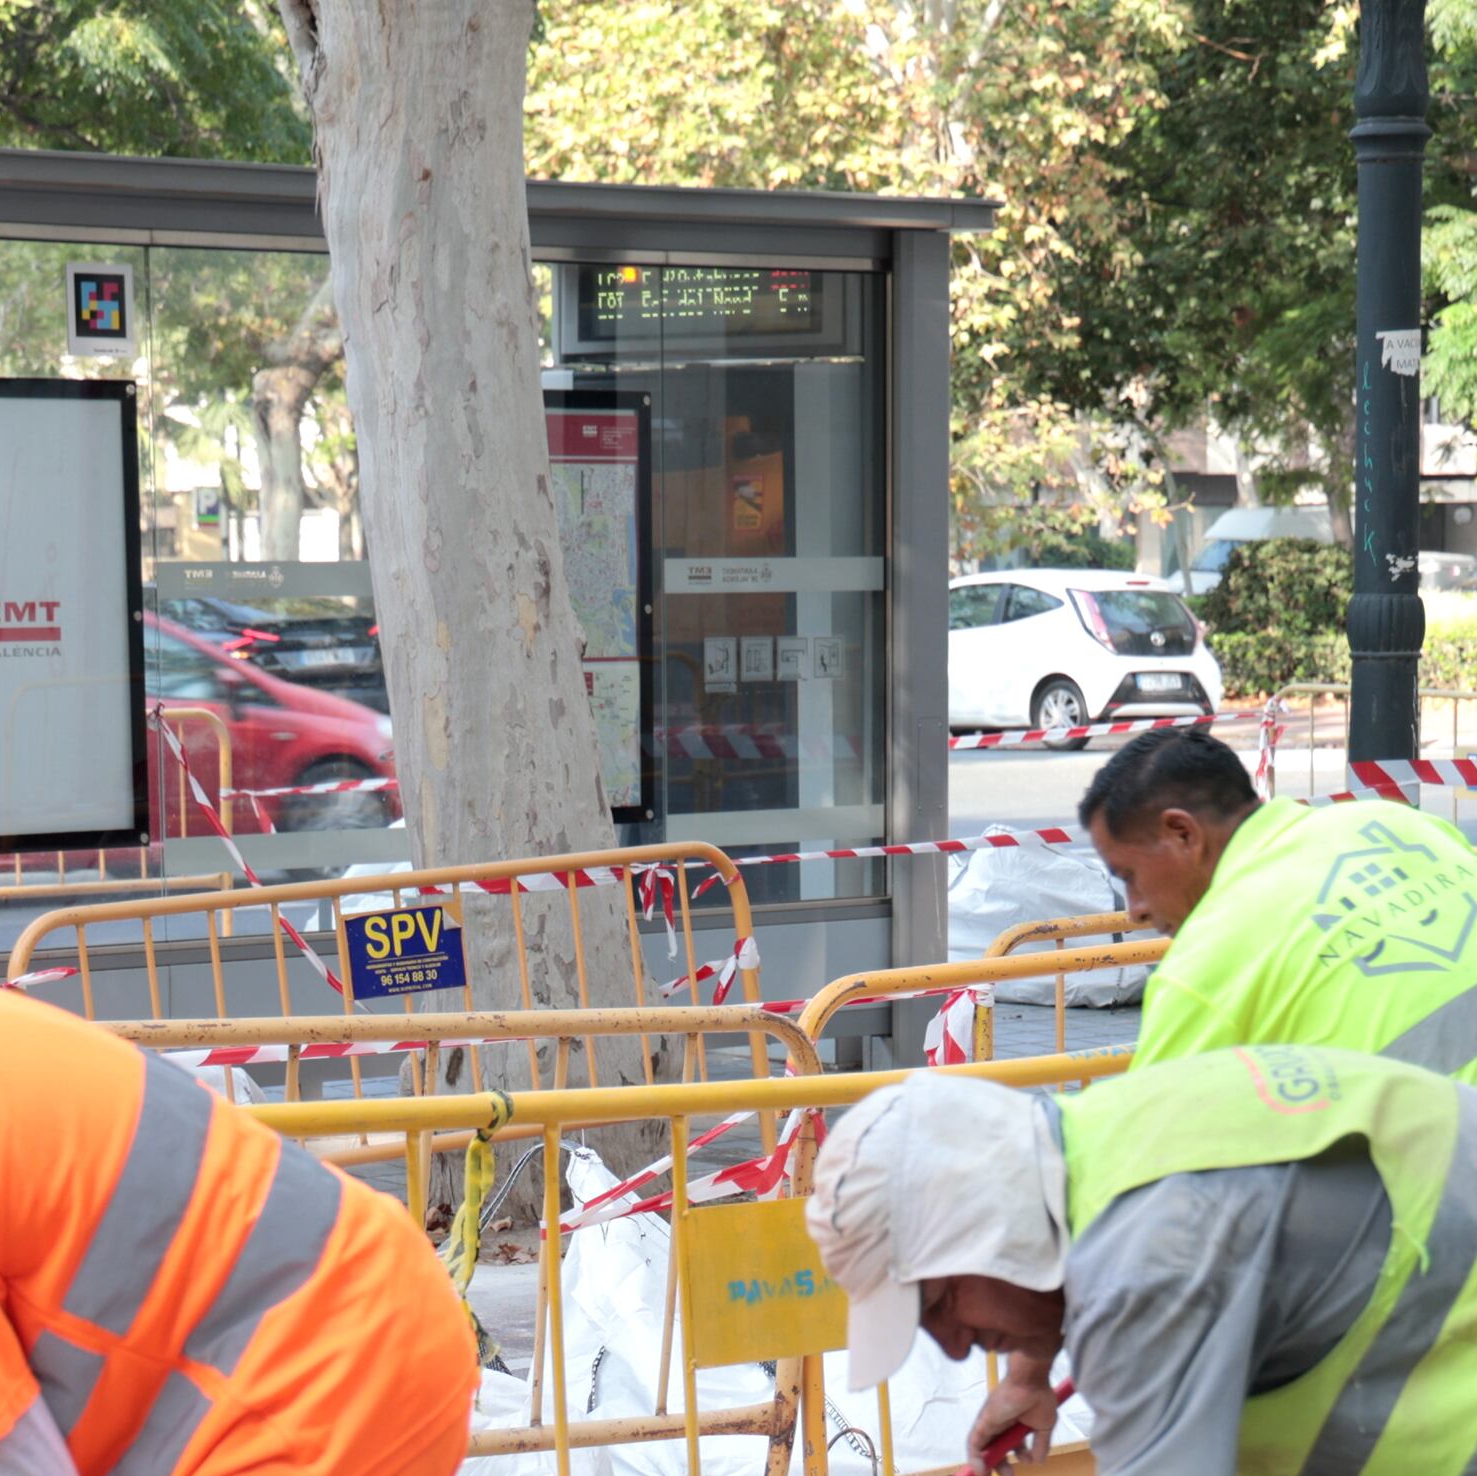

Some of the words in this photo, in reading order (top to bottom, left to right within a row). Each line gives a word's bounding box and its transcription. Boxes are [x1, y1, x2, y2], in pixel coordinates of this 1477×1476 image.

[365, 909, 442, 959] SPV
[1317, 863, 1475, 968] NAVADIRA
[380, 974, 394, 987] 96
[394, 972, 411, 985] 154
[412, 970, 425, 983] 88
[425, 969, 438, 981] 30
